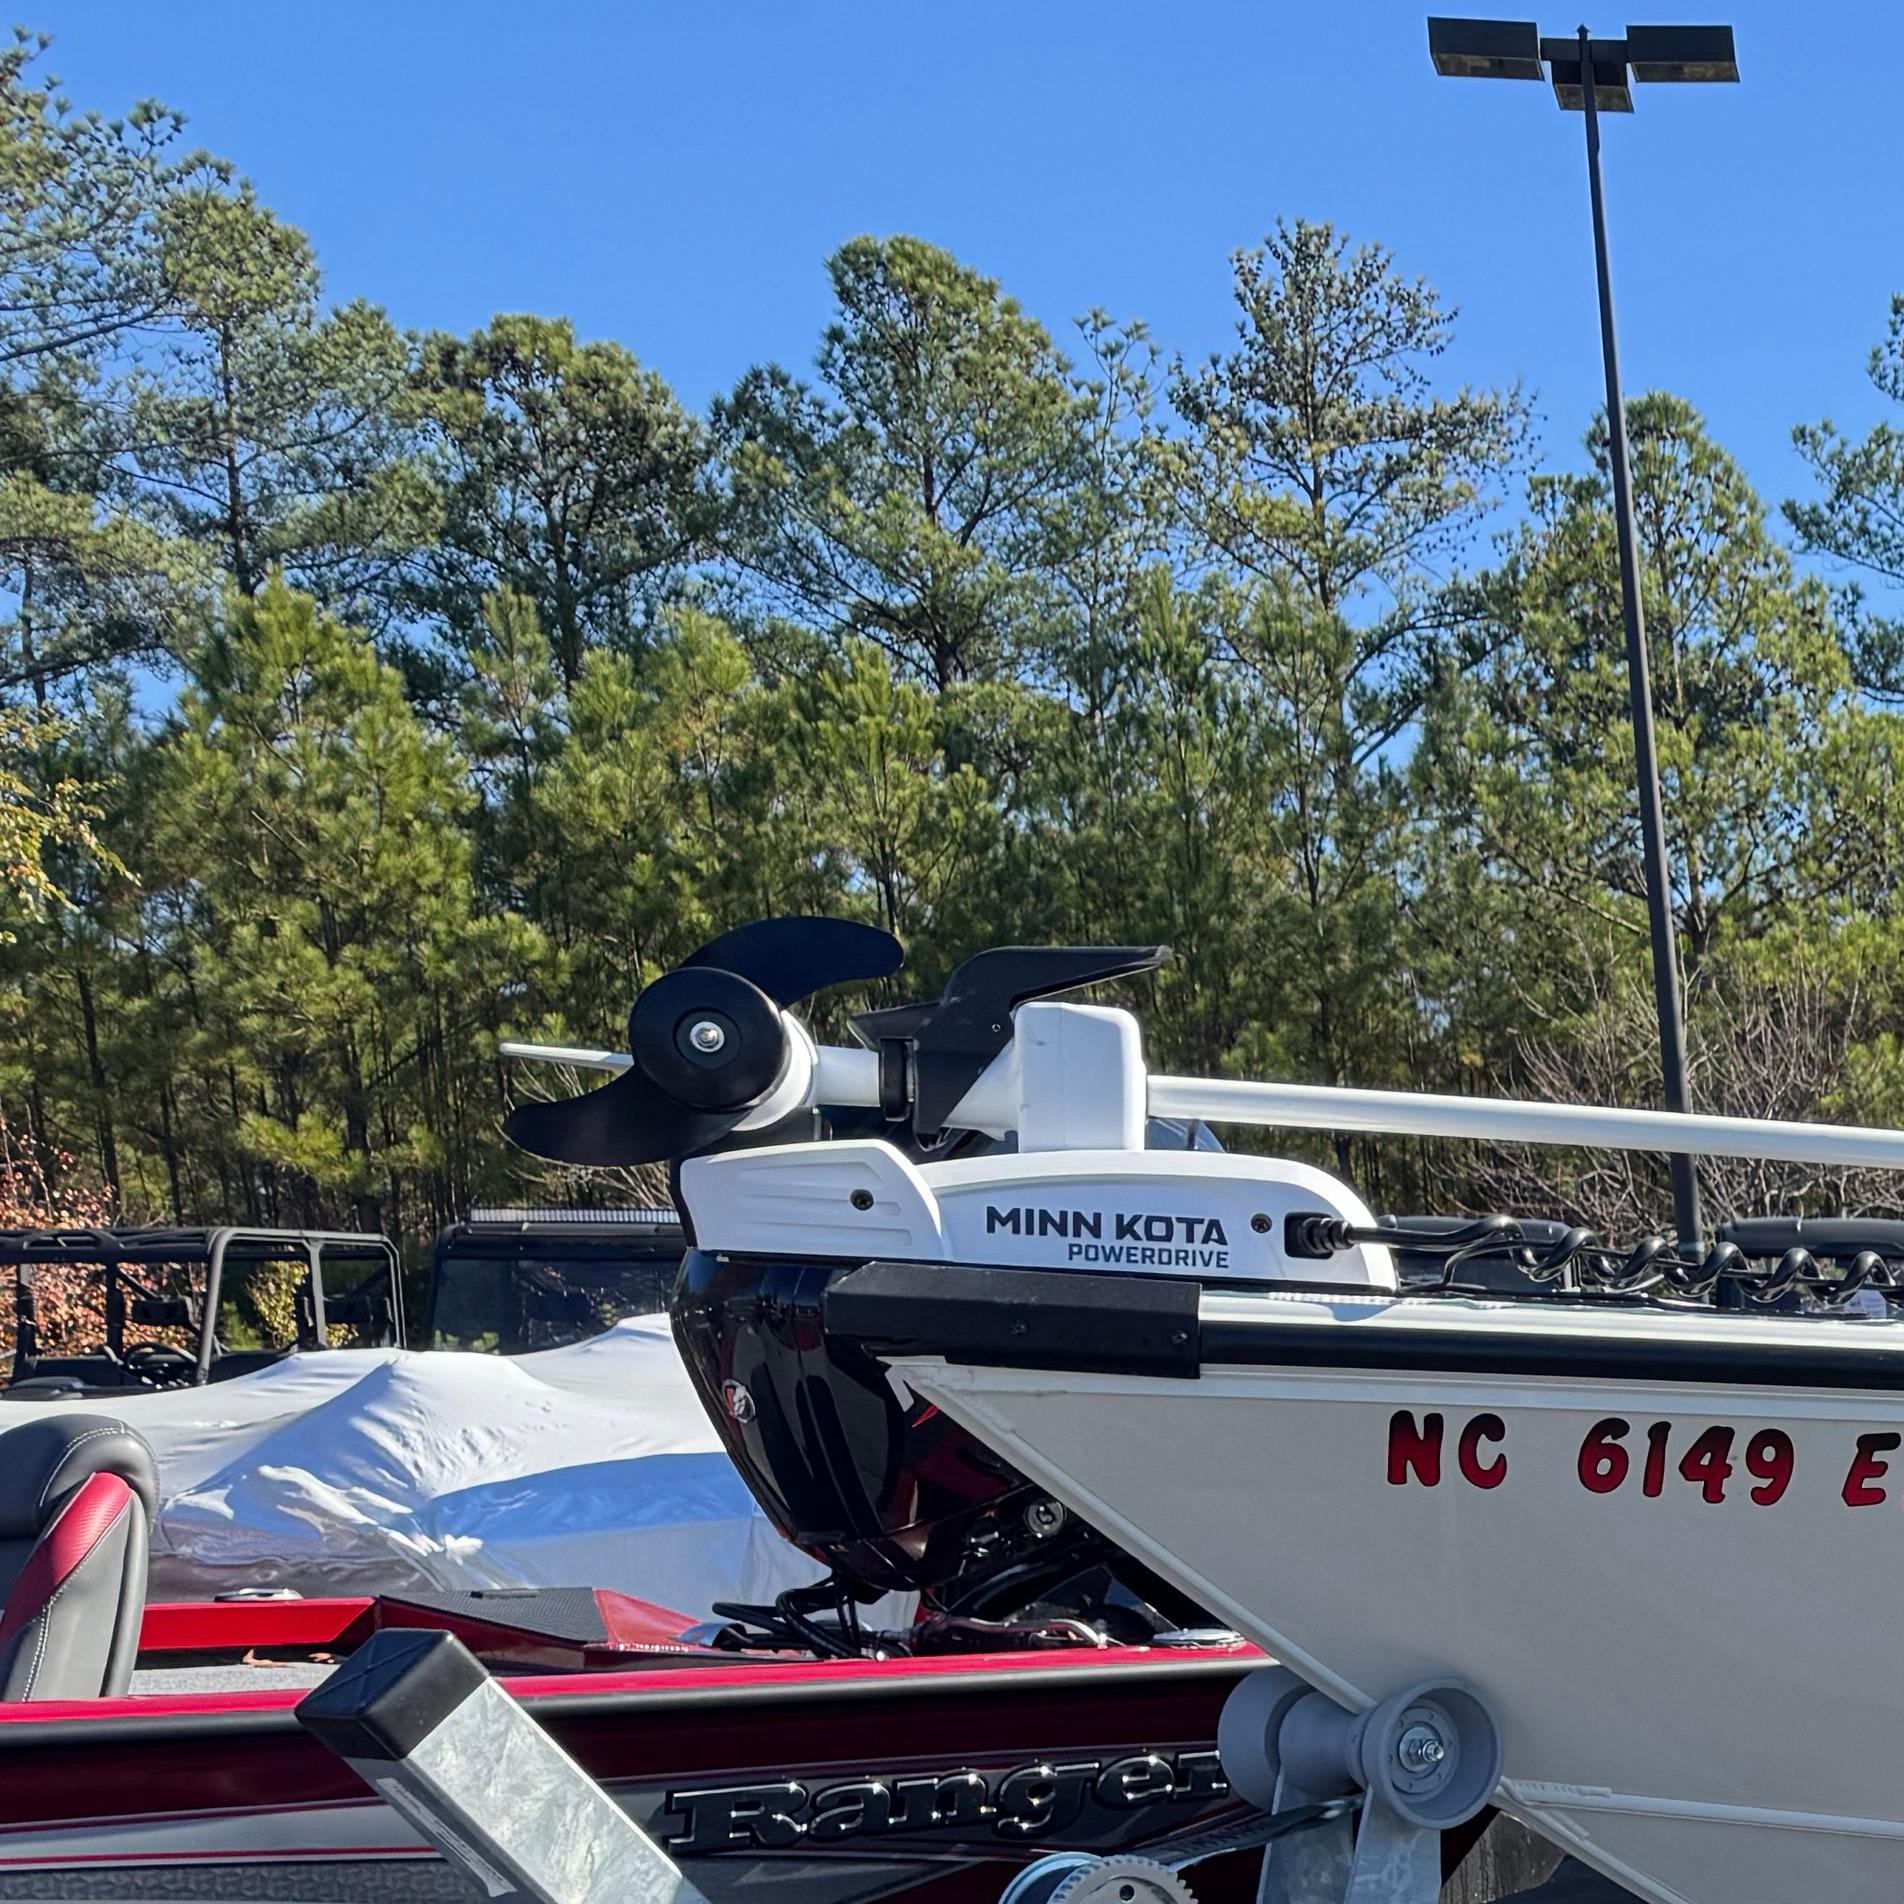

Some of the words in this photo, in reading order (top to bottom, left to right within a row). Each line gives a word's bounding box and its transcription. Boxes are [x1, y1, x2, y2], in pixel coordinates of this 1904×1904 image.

[987, 1206, 1101, 1239] MINN
[1116, 1214, 1228, 1246] KOTA
[1068, 1244, 1229, 1269] POWERDRIVE
[1386, 1410, 1508, 1490] NC
[1577, 1417, 1795, 1506] 6149
[666, 1751, 1227, 1852] Ranger
